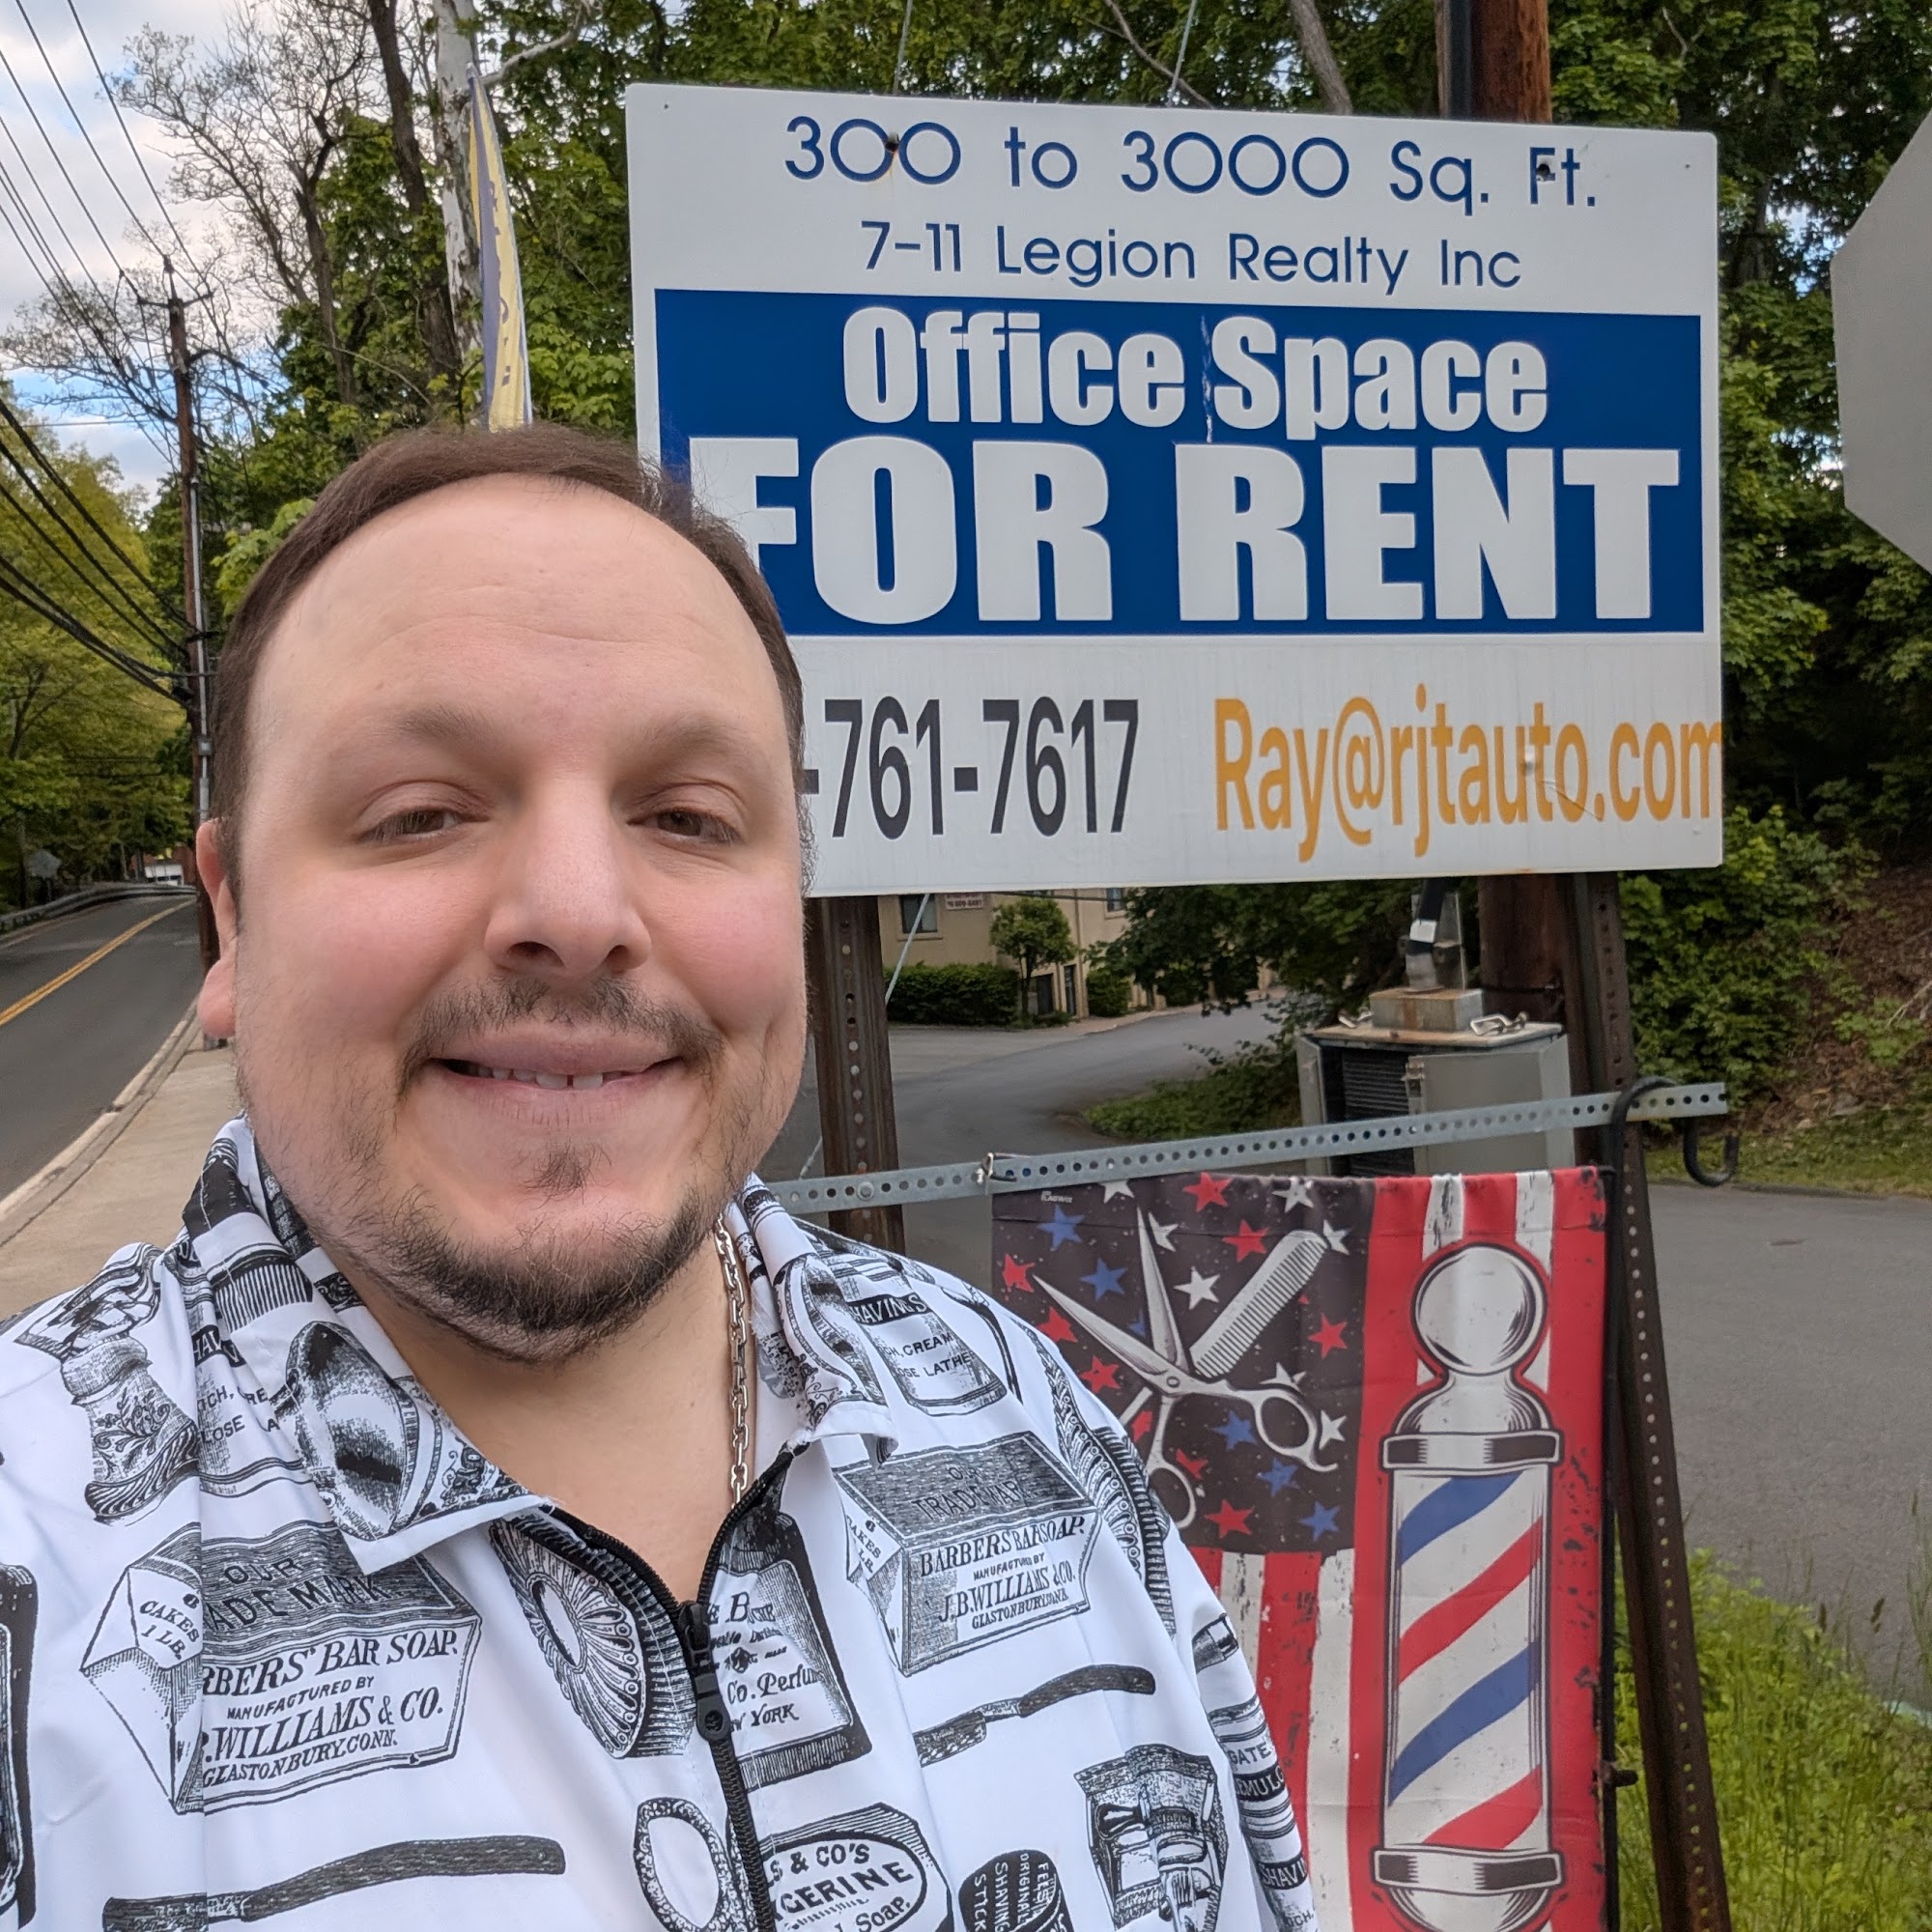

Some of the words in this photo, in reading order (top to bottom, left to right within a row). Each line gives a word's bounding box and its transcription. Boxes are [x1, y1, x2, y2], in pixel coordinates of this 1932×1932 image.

[784, 115, 961, 185] 300
[1004, 127, 1078, 188] to
[1121, 130, 1350, 198] 3000
[1390, 140, 1490, 216] Sq.
[1530, 147, 1597, 207] Ft.
[862, 221, 962, 272] 7-11
[998, 225, 1196, 288] Legion
[1229, 233, 1408, 296] Realty
[1440, 240, 1521, 288] Inc
[843, 306, 1185, 428] Office
[1211, 316, 1547, 440] Space
[689, 436, 1113, 625] FOR
[1175, 443, 1680, 621] RENT
[1213, 682, 1722, 863] Ray@rjtauto.com
[314, 1638, 381, 1676] BAR
[227, 1679, 353, 1719] MANUFACTURED
[355, 1676, 375, 1690] BY
[377, 1695, 395, 1725] &
[400, 1687, 443, 1722] CO.
[790, 1851, 810, 1875] &
[815, 1842, 870, 1867] CO'S
